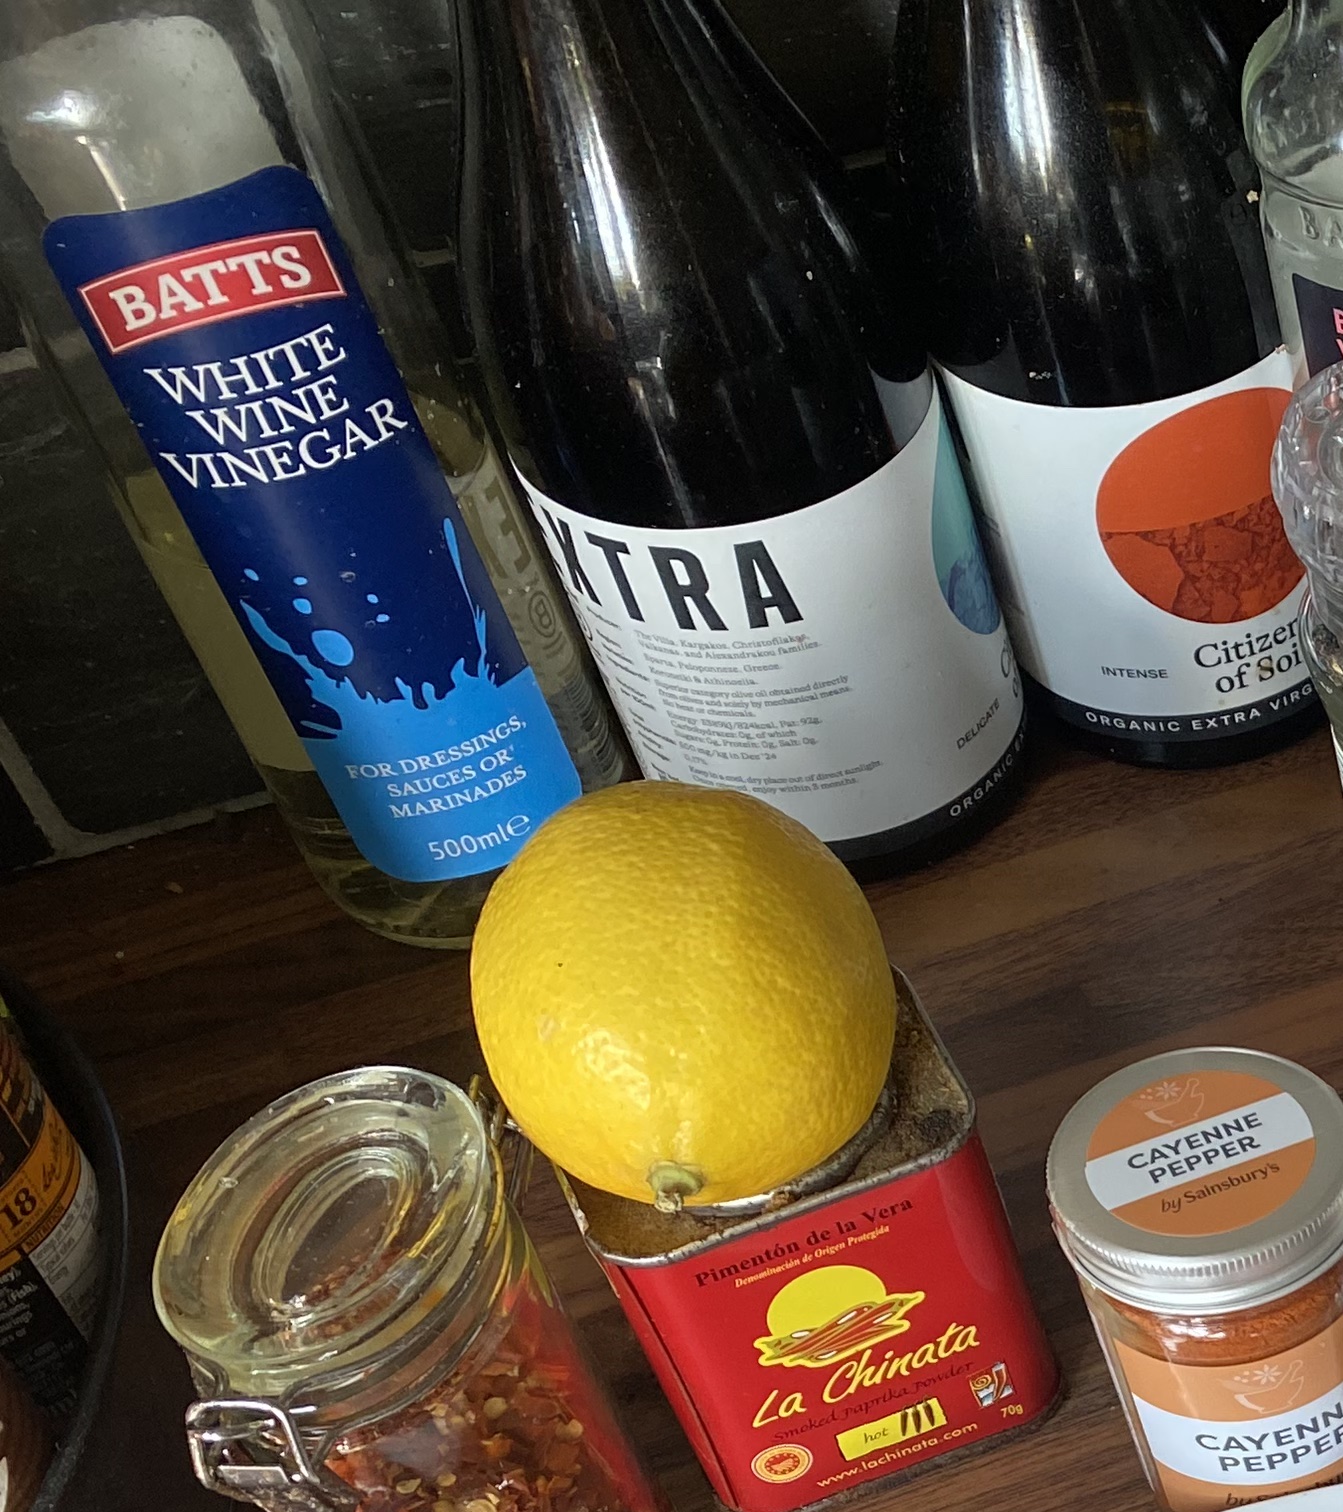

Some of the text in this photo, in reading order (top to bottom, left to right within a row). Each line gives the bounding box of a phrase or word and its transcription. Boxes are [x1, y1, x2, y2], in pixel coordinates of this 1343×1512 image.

[109, 246, 311, 331] BATTS
[143, 324, 346, 405] WHITE
[185, 375, 349, 445] WINE
[159, 398, 408, 489] VINEGAR
[530, 497, 804, 632] XTRA
[1101, 665, 1169, 679] INTENSE
[1215, 643, 1303, 693] of Soi
[345, 714, 527, 779] FOR DRESSINGS,
[957, 697, 1000, 750] DELICATE
[1085, 708, 1261, 732] ORGANIC EXTRA
[387, 749, 513, 797] SAUCES OR
[388, 765, 527, 819] MARINADES
[950, 753, 1014, 817] ORGANIC
[1127, 1112, 1263, 1170] CAYENNE
[1148, 1136, 1261, 1184] PEPPER
[1, 1187, 37, 1230] 18
[1161, 1161, 1280, 1214] by Sainsbury's
[694, 1199, 914, 1287] Pimentón de la Vera
[734, 1224, 890, 1288] Denominación de Origen Protegida
[752, 1322, 980, 1428] La Chinata
[912, 1361, 975, 1396] powder
[863, 1427, 889, 1445] hot
[1000, 1404, 1023, 1419] 70g
[816, 1422, 978, 1487] www.lachinata.com
